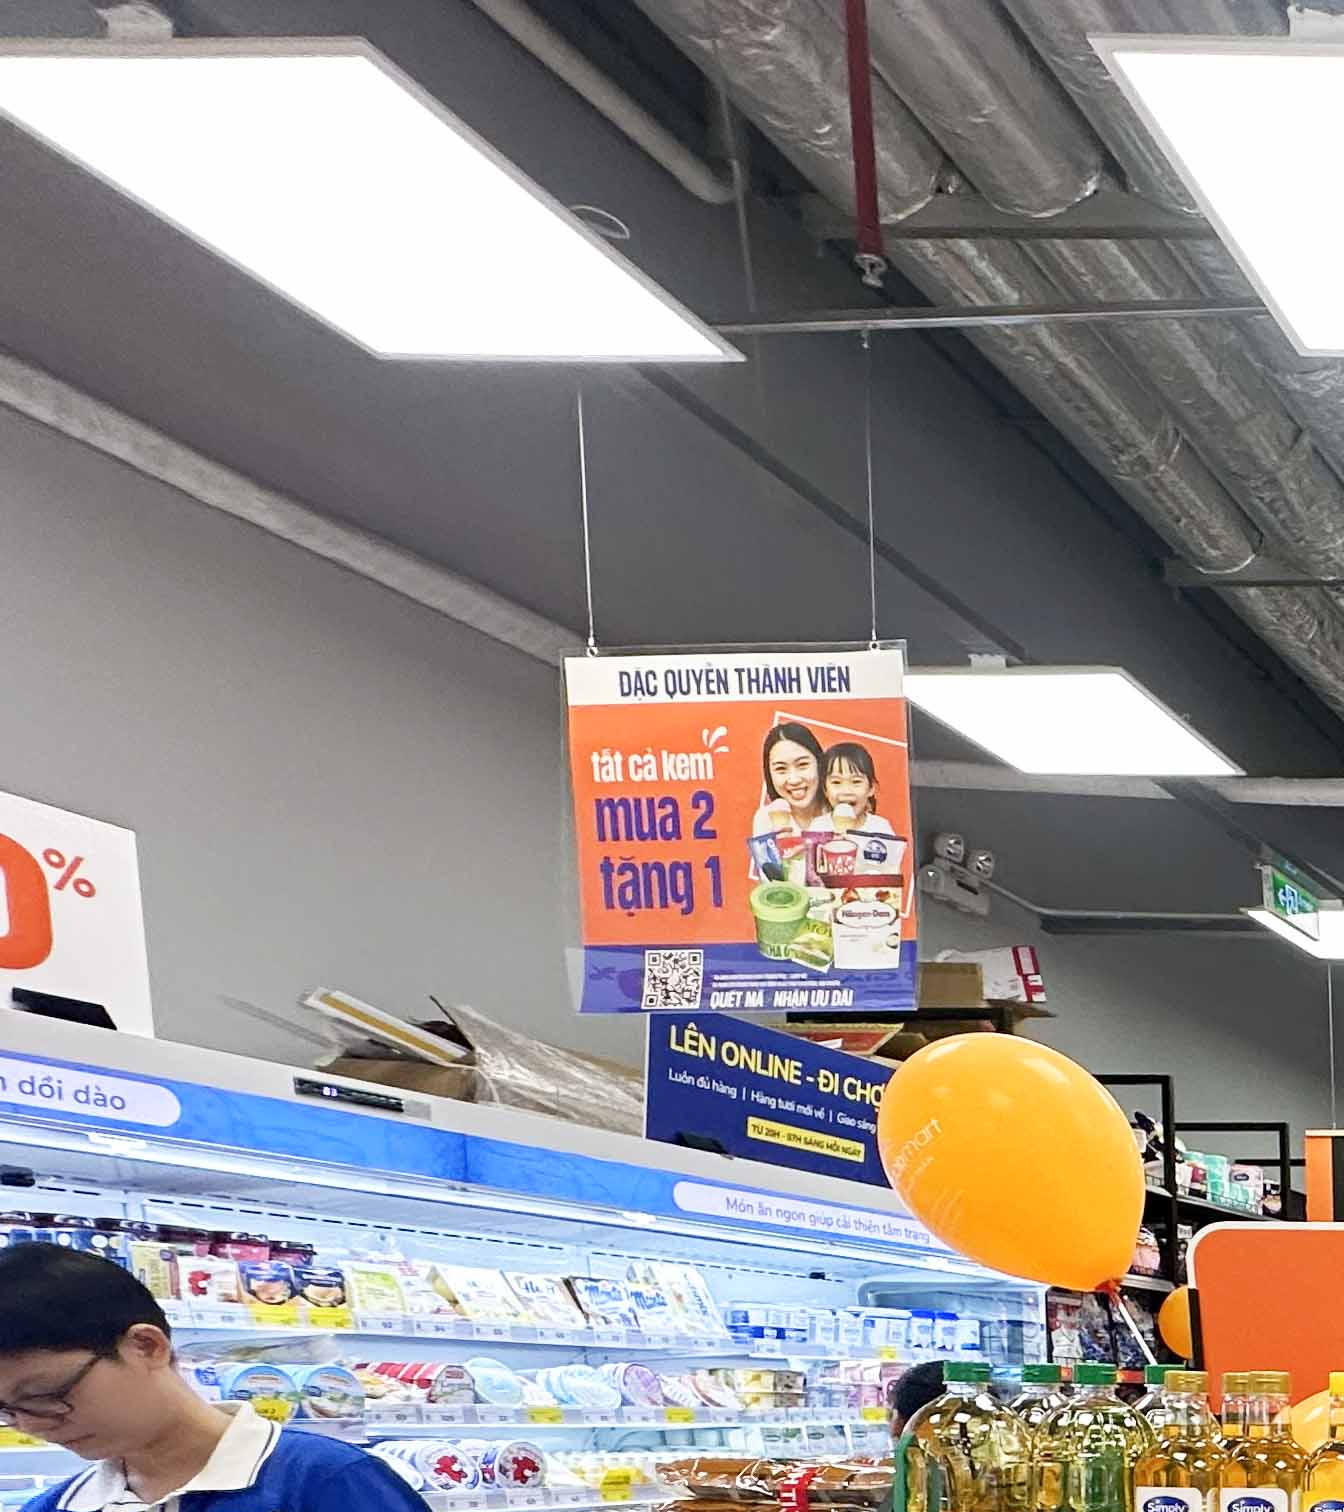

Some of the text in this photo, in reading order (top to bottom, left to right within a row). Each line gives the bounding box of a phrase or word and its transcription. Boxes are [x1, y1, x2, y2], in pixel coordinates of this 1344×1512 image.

[662, 750, 713, 780] kem
[595, 790, 717, 841] mua 2
[601, 855, 723, 916] tặng 1
[669, 1022, 887, 1112] LÊN ONLINE ĐI CHỢ
[18, 1075, 126, 1110] dồi dào
[726, 1197, 753, 1216] Món
[776, 1207, 805, 1226] ngon
